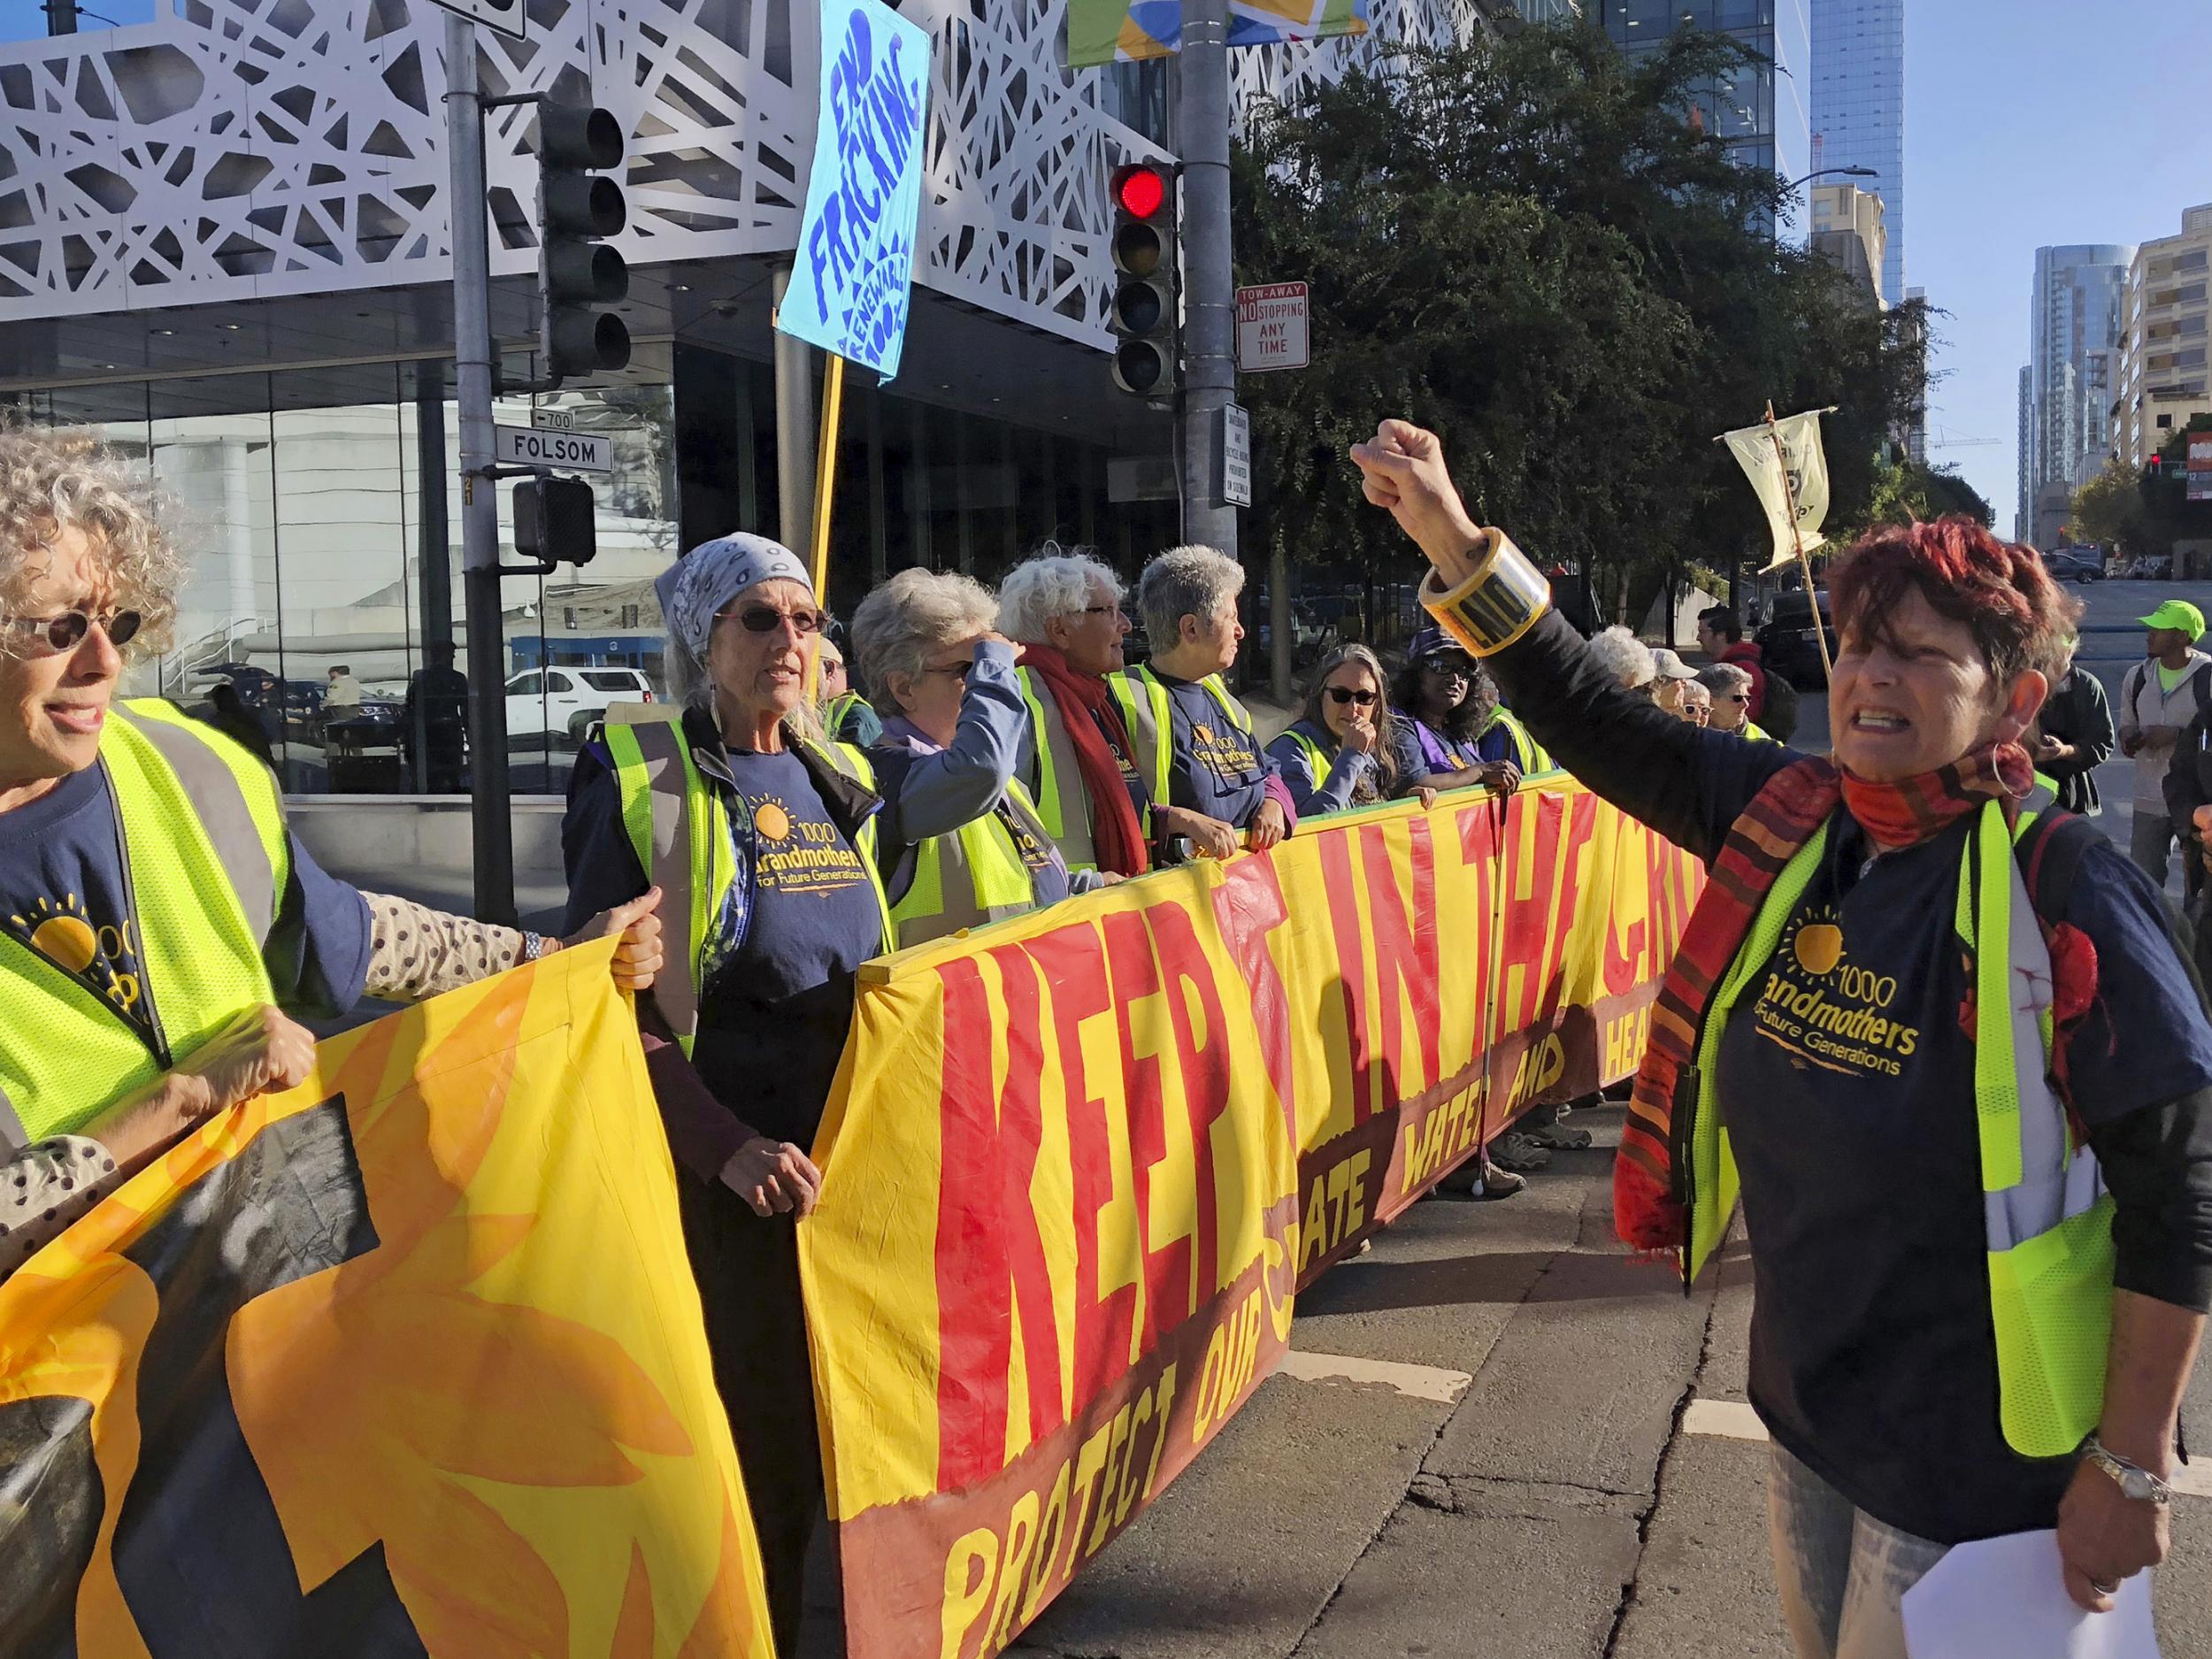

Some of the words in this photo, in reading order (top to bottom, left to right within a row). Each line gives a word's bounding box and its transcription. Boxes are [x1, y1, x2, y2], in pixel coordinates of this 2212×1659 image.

[830, 8, 872, 162] END
[809, 32, 920, 326] FRACKING
[1241, 285, 1302, 300] TOW-AWAY
[1240, 302, 1256, 321] NO
[1258, 302, 1304, 320] STOPPING
[1260, 322, 1286, 338] ANY
[1257, 339, 1288, 355] TIME
[548, 413, 571, 428] 700
[514, 435, 595, 463] FOLSOM
[797, 822, 836, 843] 1000
[757, 875, 775, 887] for
[777, 872, 810, 884] Future
[1838, 964, 1897, 1008] 1000
[1763, 972, 1919, 1056] andmothers
[1804, 1031, 1901, 1076] Generations
[934, 900, 1231, 1494] KEEP
[1317, 818, 1441, 1125] IN
[1455, 791, 1598, 1064] THE
[940, 1362, 1177, 1659] PROTECT
[1193, 1286, 1262, 1445] OUR
[1503, 1032, 1565, 1118] AND
